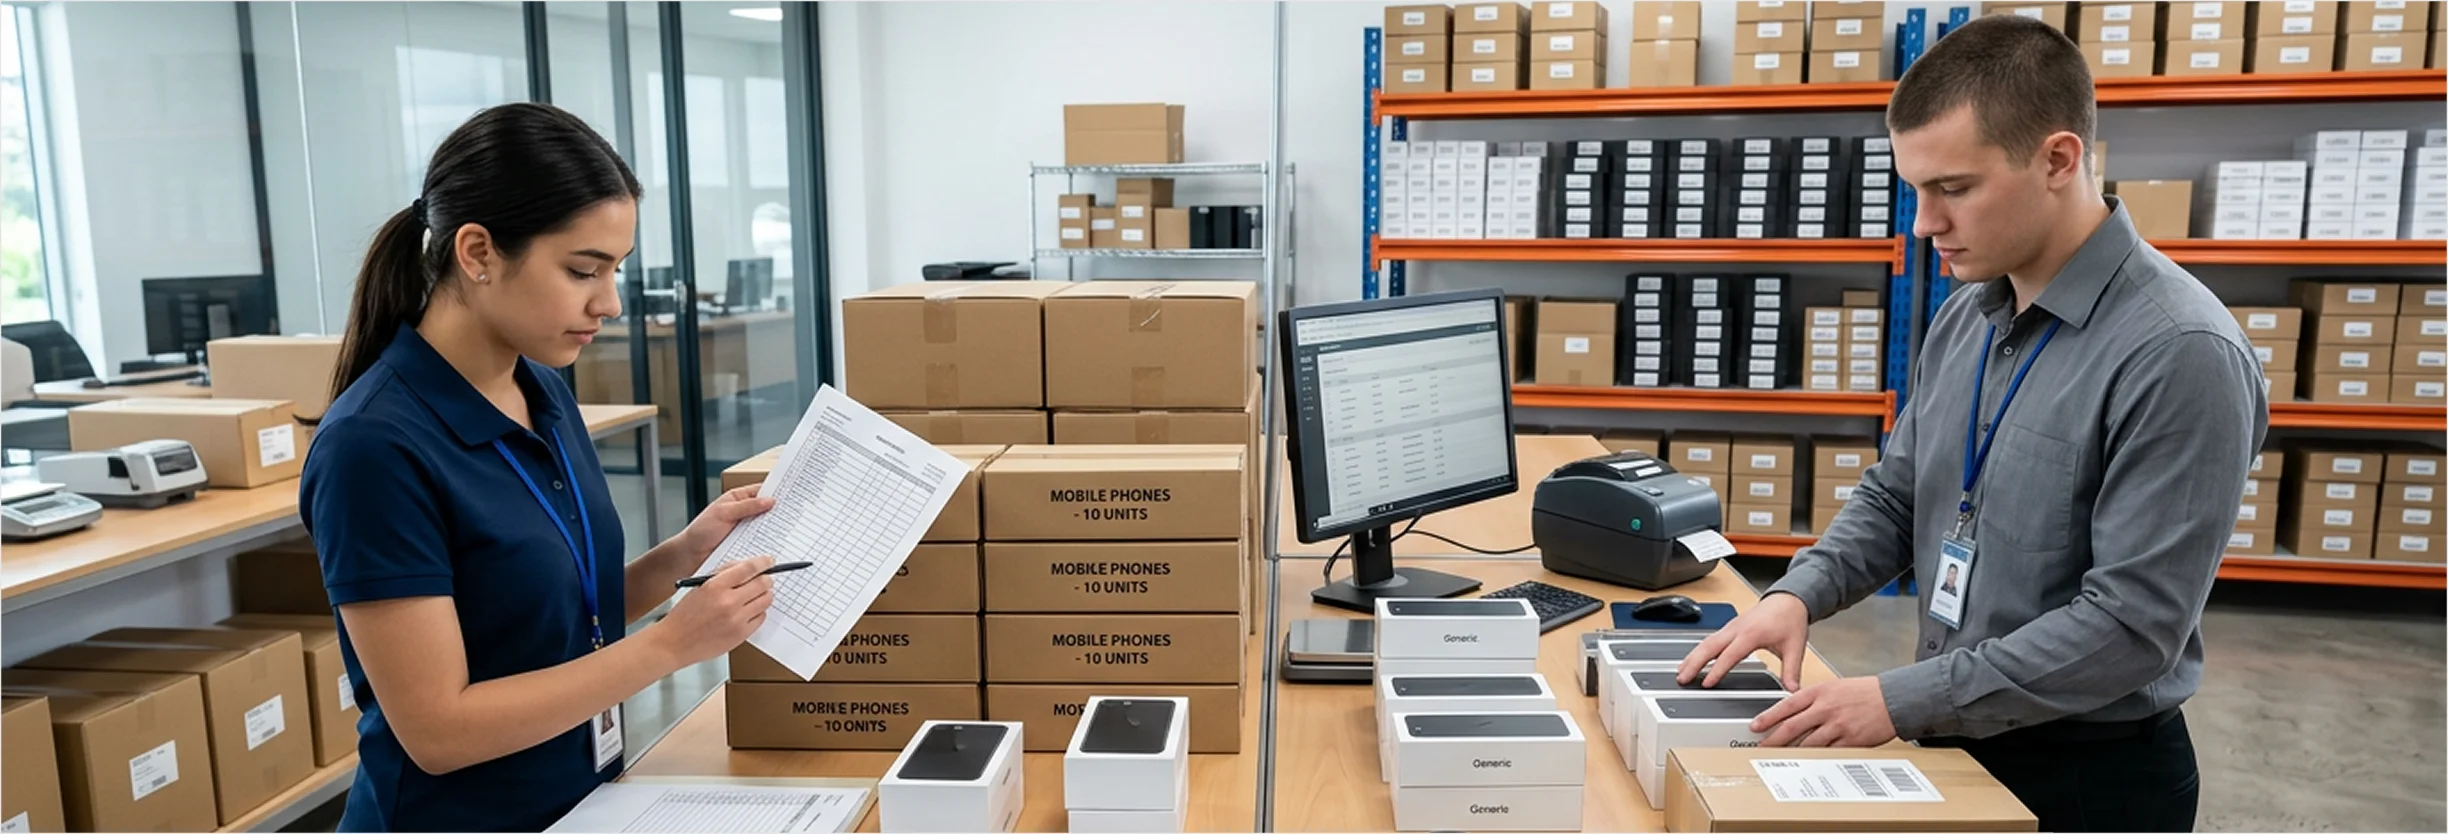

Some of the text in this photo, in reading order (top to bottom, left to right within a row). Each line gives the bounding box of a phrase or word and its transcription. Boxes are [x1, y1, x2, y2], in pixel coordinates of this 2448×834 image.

[1050, 488, 1171, 502] MOBILE PHONES
[1083, 508, 1100, 520] 10
[1103, 508, 1148, 520] UNITS
[1084, 581, 1101, 593] 10
[1104, 581, 1148, 593] UNITS
[850, 634, 910, 647] PHONES
[1052, 634, 1171, 647] MOBILE PHONES
[844, 652, 887, 665] UNITS
[1085, 652, 1102, 664] 10
[1105, 652, 1148, 664] UNITS
[850, 702, 909, 715] PHONES
[825, 720, 841, 732] 10
